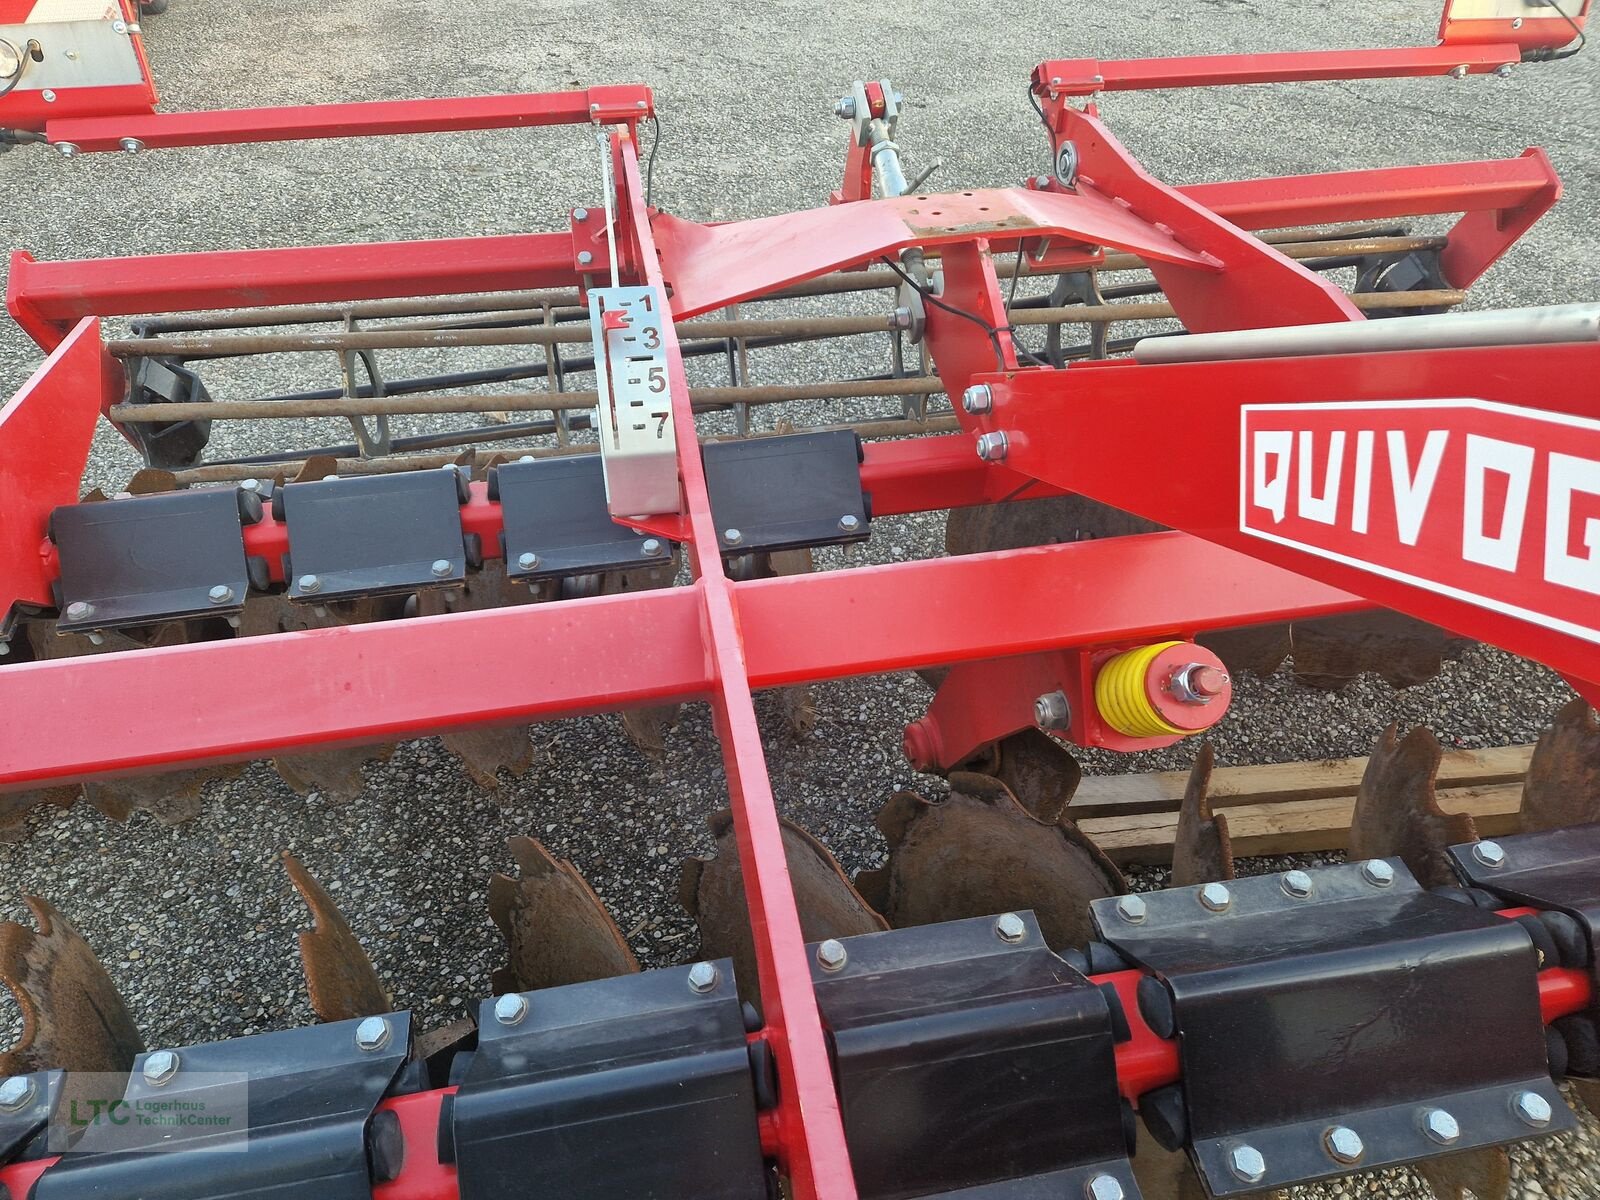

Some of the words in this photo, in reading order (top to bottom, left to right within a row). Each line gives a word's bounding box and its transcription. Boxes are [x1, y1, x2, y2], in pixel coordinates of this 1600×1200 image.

[639, 294, 652, 312] 1
[642, 326, 661, 350] 3
[648, 366, 666, 393] 5
[651, 411, 669, 439] 7
